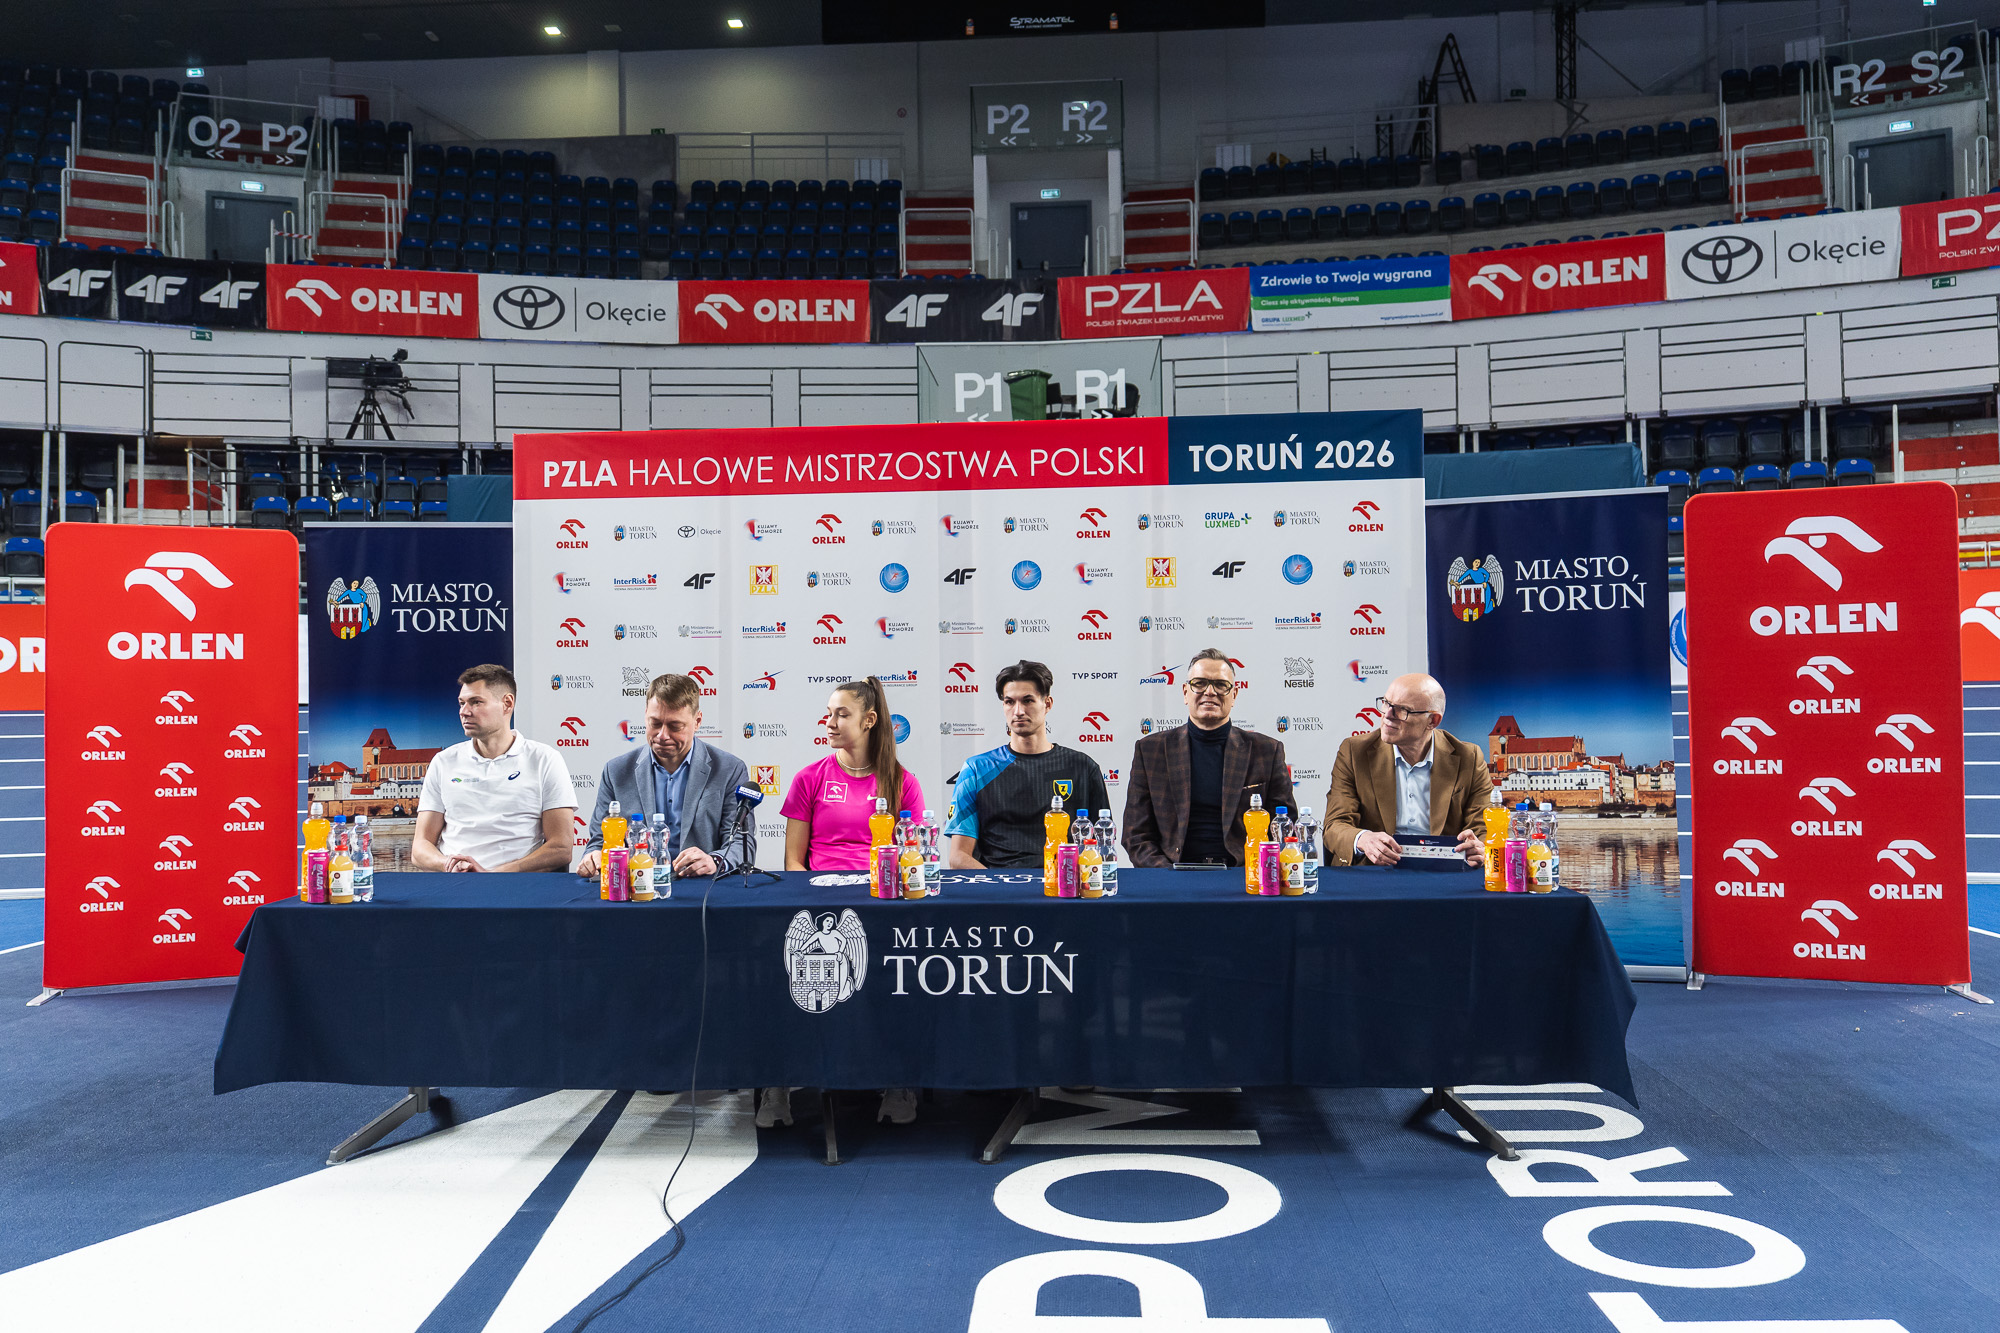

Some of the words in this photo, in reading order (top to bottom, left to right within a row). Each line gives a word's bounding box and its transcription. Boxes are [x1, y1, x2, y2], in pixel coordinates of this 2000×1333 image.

[1010, 16, 1075, 27] STRAMATEL
[1833, 59, 1886, 96] R2
[1911, 46, 1964, 84] S2
[987, 104, 1030, 134] P2
[1062, 100, 1108, 131] R2
[187, 115, 241, 149] O2
[262, 122, 308, 155] P2
[1787, 234, 1886, 264] Okęcie
[1939, 248, 1977, 259] POLSKI
[1532, 255, 1647, 289] ORLEN
[48, 268, 112, 297] 4F
[1261, 274, 1313, 287] Zdrowie
[1315, 273, 1329, 284] to
[1331, 271, 1370, 285] Twoja
[1373, 269, 1432, 282] wygrana
[125, 275, 187, 303] 4F
[200, 281, 259, 308] 4F
[351, 288, 462, 316] ORLEN
[1085, 279, 1223, 316] PZLA
[585, 301, 667, 327] Okęcie
[754, 299, 855, 322] ORLEN
[885, 294, 949, 327] 4F
[982, 293, 1044, 326] 4F
[1117, 318, 1153, 326] ZWIĄZEK
[954, 371, 1002, 413] P1
[1076, 368, 1127, 410] R1
[1189, 434, 1302, 472] TORUŃ
[1315, 440, 1394, 468] 2026
[544, 460, 617, 487] PZLA
[630, 456, 773, 485] HALOWE
[785, 451, 1018, 482] MISTRZOSTWA
[1031, 447, 1143, 476] POLSKI
[1205, 512, 1235, 520] GRUPA
[1290, 516, 1320, 525] TORUŃ
[1019, 522, 1049, 532] TORUŃ
[1154, 519, 1184, 528] TORUŃ
[1205, 520, 1240, 528] LUXMED
[1349, 524, 1383, 532] ORLEN
[629, 530, 657, 539] TORUŃ
[700, 528, 722, 536] Okęcie
[887, 526, 916, 534] TORUŃ
[556, 541, 588, 549] ORLEN
[812, 536, 845, 544] ORLEN
[1212, 561, 1245, 578] 4F
[1360, 565, 1390, 575] TORUŃ
[1514, 555, 1629, 581] MIASTO
[684, 573, 715, 589] 4F
[822, 577, 851, 586] TORUŃ
[944, 568, 976, 585] 4F
[1148, 578, 1174, 587] PZLA
[391, 583, 493, 603] MIASTO
[751, 585, 777, 594] PZLA
[1516, 574, 1647, 613] TORUŃ
[391, 600, 509, 633] TORUŃ
[1275, 616, 1310, 624] InterRisk
[1750, 602, 1897, 636] ORLEN
[1021, 624, 1050, 633] TORUŃ
[1155, 622, 1185, 630] TORUŃ
[1350, 627, 1385, 635] ORLEN
[629, 630, 658, 638] TORUŃ
[1078, 632, 1111, 640] ORLEN
[108, 632, 243, 659] ORLEN
[825, 675, 852, 683] SPORT
[1072, 672, 1090, 680] TVP
[1091, 672, 1118, 680] SPORT
[1139, 677, 1166, 686] polanik
[566, 680, 594, 688] TORUŃ
[743, 682, 769, 690] polanik
[945, 685, 978, 693] ORLEN
[1284, 679, 1315, 688] Nestlé
[1789, 699, 1860, 714] ORLEN
[155, 716, 197, 724] ORLEN
[1293, 722, 1324, 731] TORUŃ
[759, 728, 788, 737] TORUŃ
[1079, 734, 1113, 742] ORLEN
[81, 751, 125, 760] ORLEN
[224, 749, 266, 759] ORLEN
[1713, 760, 1782, 774] ORLEN
[1867, 758, 1941, 773] ORLEN
[155, 788, 197, 797] ORLEN
[81, 826, 125, 836] ORLEN
[224, 822, 264, 831] ORLEN
[1791, 821, 1862, 836] ORLEN
[154, 860, 196, 870] ORLEN
[1715, 881, 1784, 897] ORLEN
[1869, 884, 1942, 899] ORLEN
[222, 895, 264, 906] ORLEN
[80, 901, 124, 913] ORLEN
[153, 933, 195, 944] ORLEN
[892, 926, 1034, 948] MIASTO
[1793, 943, 1865, 960] ORLEN
[883, 941, 1079, 996] TORUŃ
